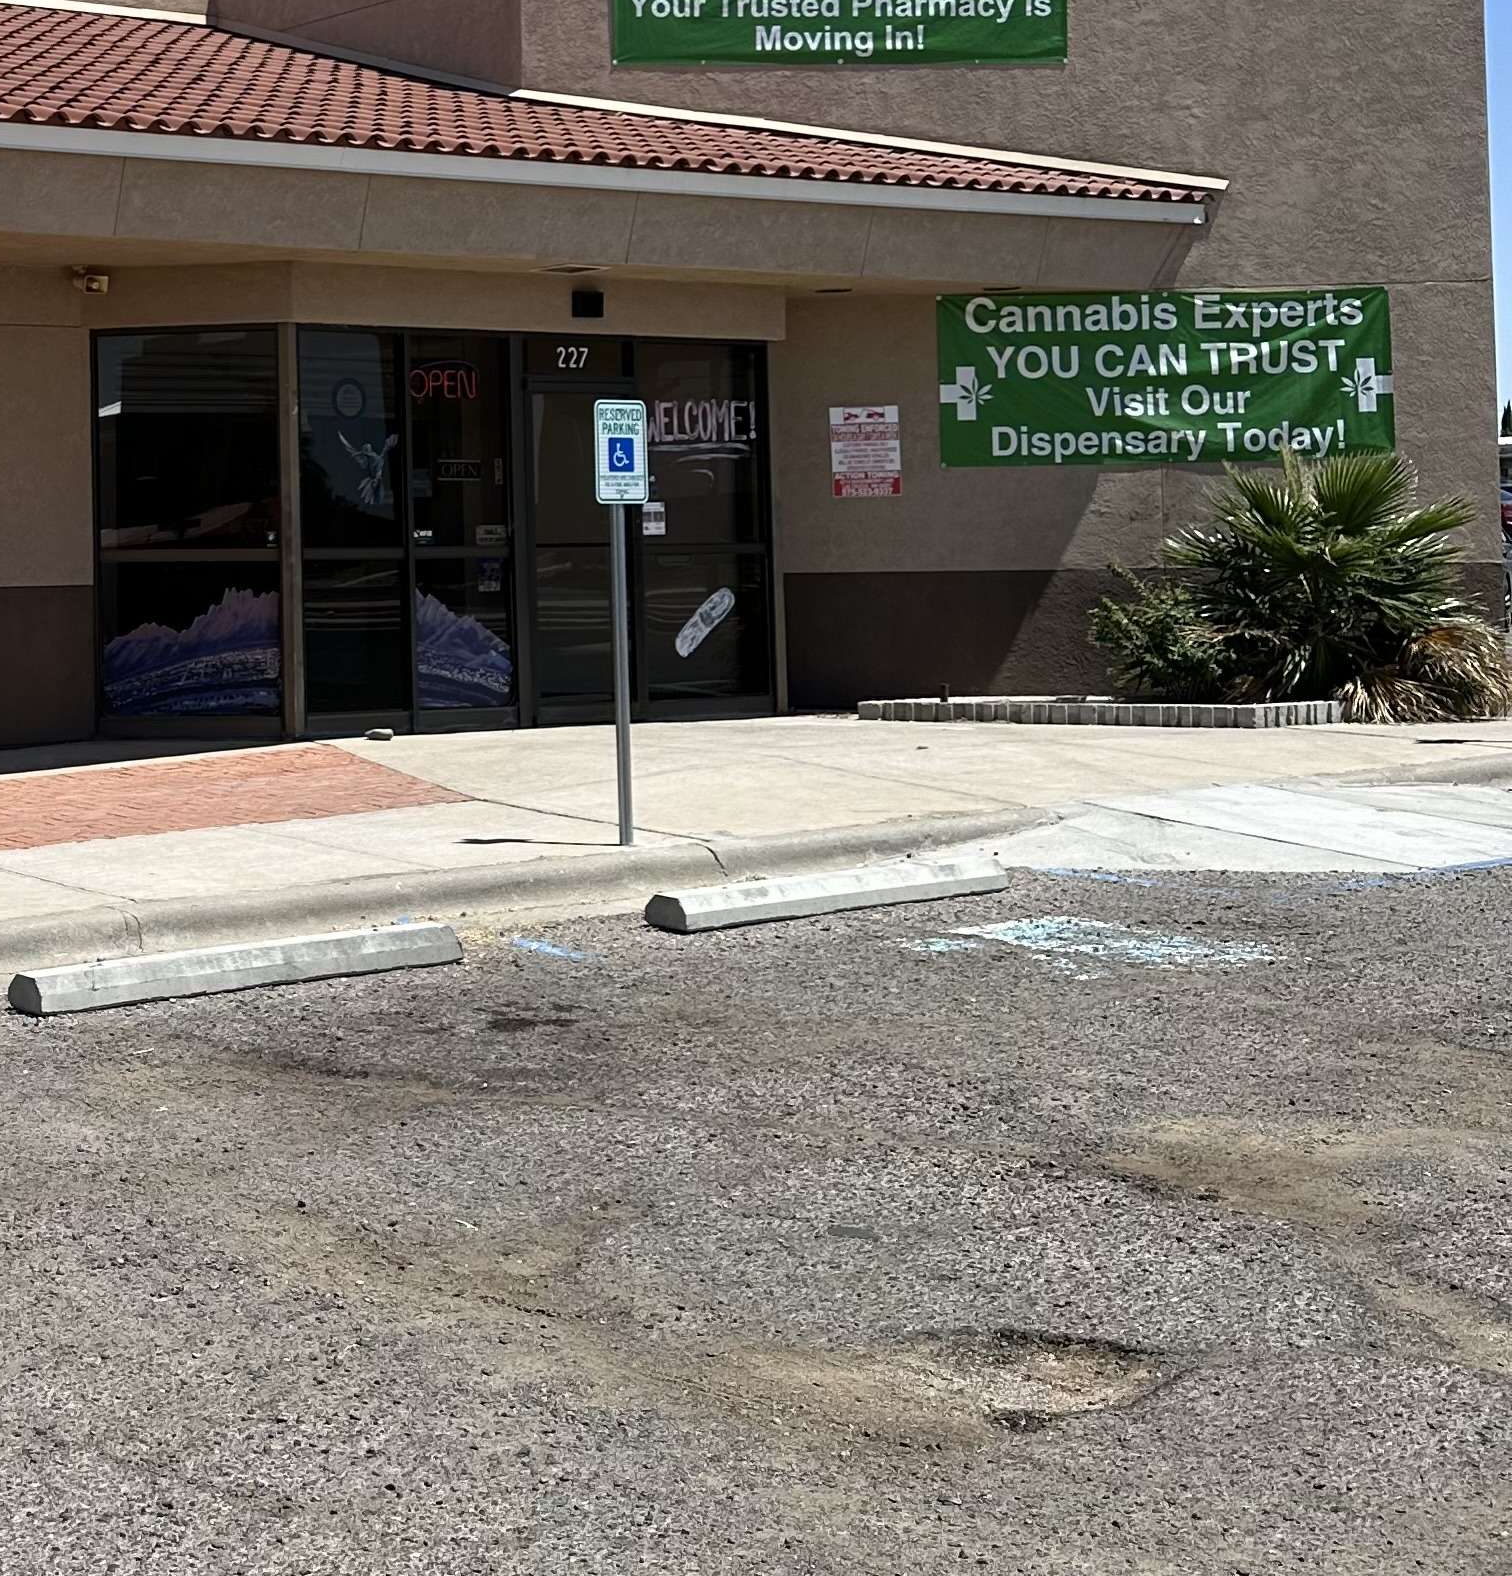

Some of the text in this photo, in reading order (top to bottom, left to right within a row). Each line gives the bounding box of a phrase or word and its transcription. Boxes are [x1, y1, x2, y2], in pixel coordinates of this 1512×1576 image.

[755, 24, 924, 57] Moving In!
[963, 292, 1364, 338] Cannabis Experts
[555, 345, 590, 369] 227
[986, 339, 1346, 380] YOU CAN TRUST
[408, 367, 479, 400] OPEN
[599, 407, 642, 422] RESERVED
[1085, 384, 1252, 418] Visit Our
[602, 422, 640, 436] PARKING
[991, 419, 1346, 464] Dispensary Today!
